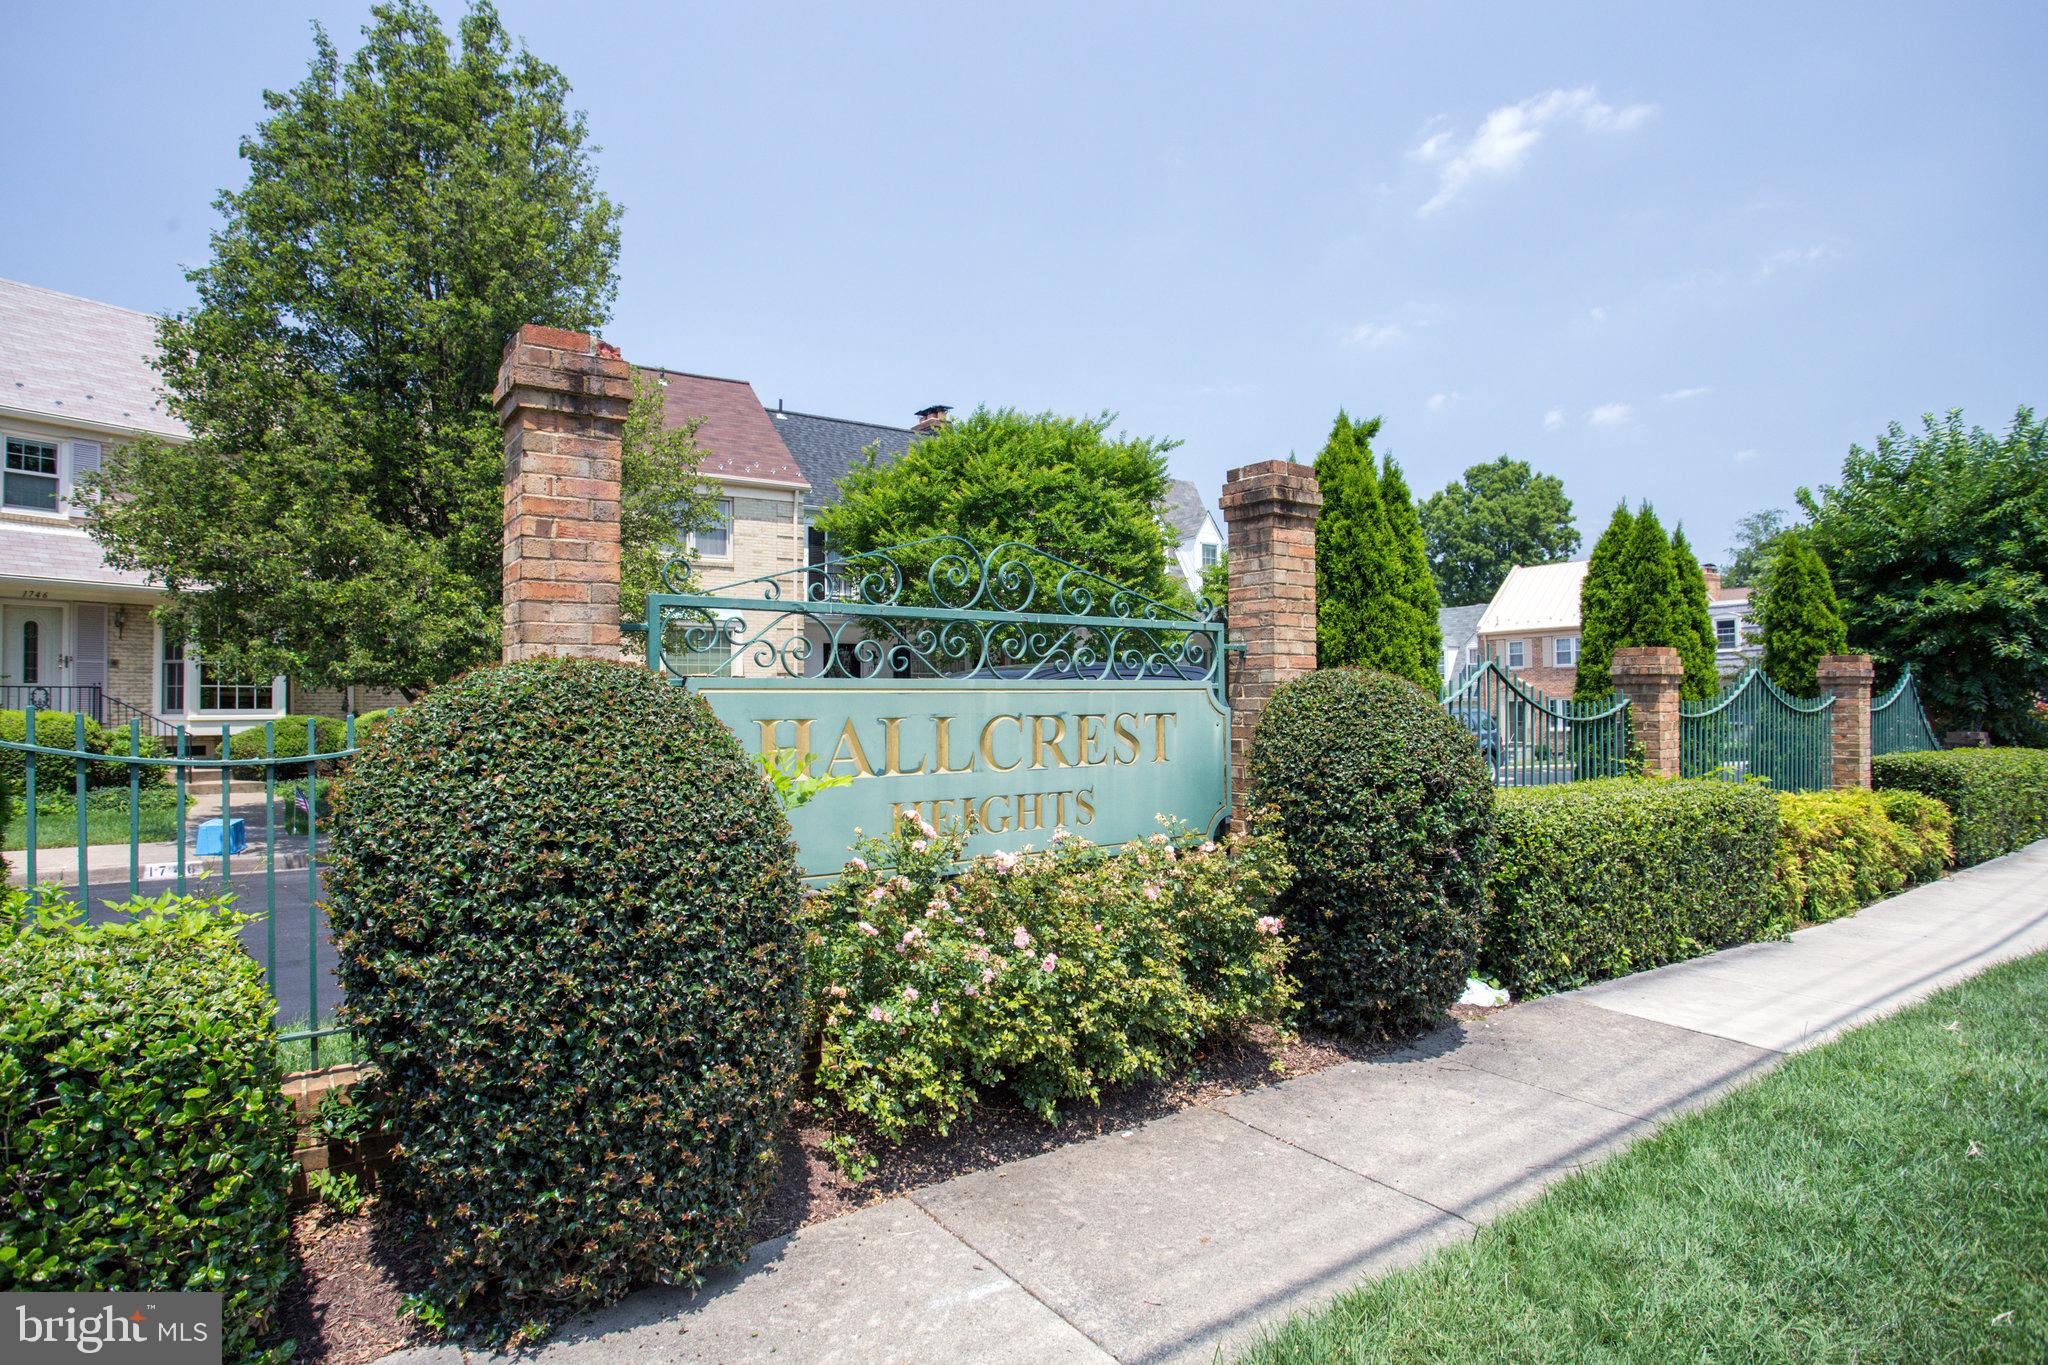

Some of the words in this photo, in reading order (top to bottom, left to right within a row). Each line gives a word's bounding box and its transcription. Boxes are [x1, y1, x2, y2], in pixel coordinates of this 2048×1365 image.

[22, 590, 48, 599] 1746
[752, 711, 1178, 781] HALLCREST
[888, 784, 1097, 837] HEIGHTS
